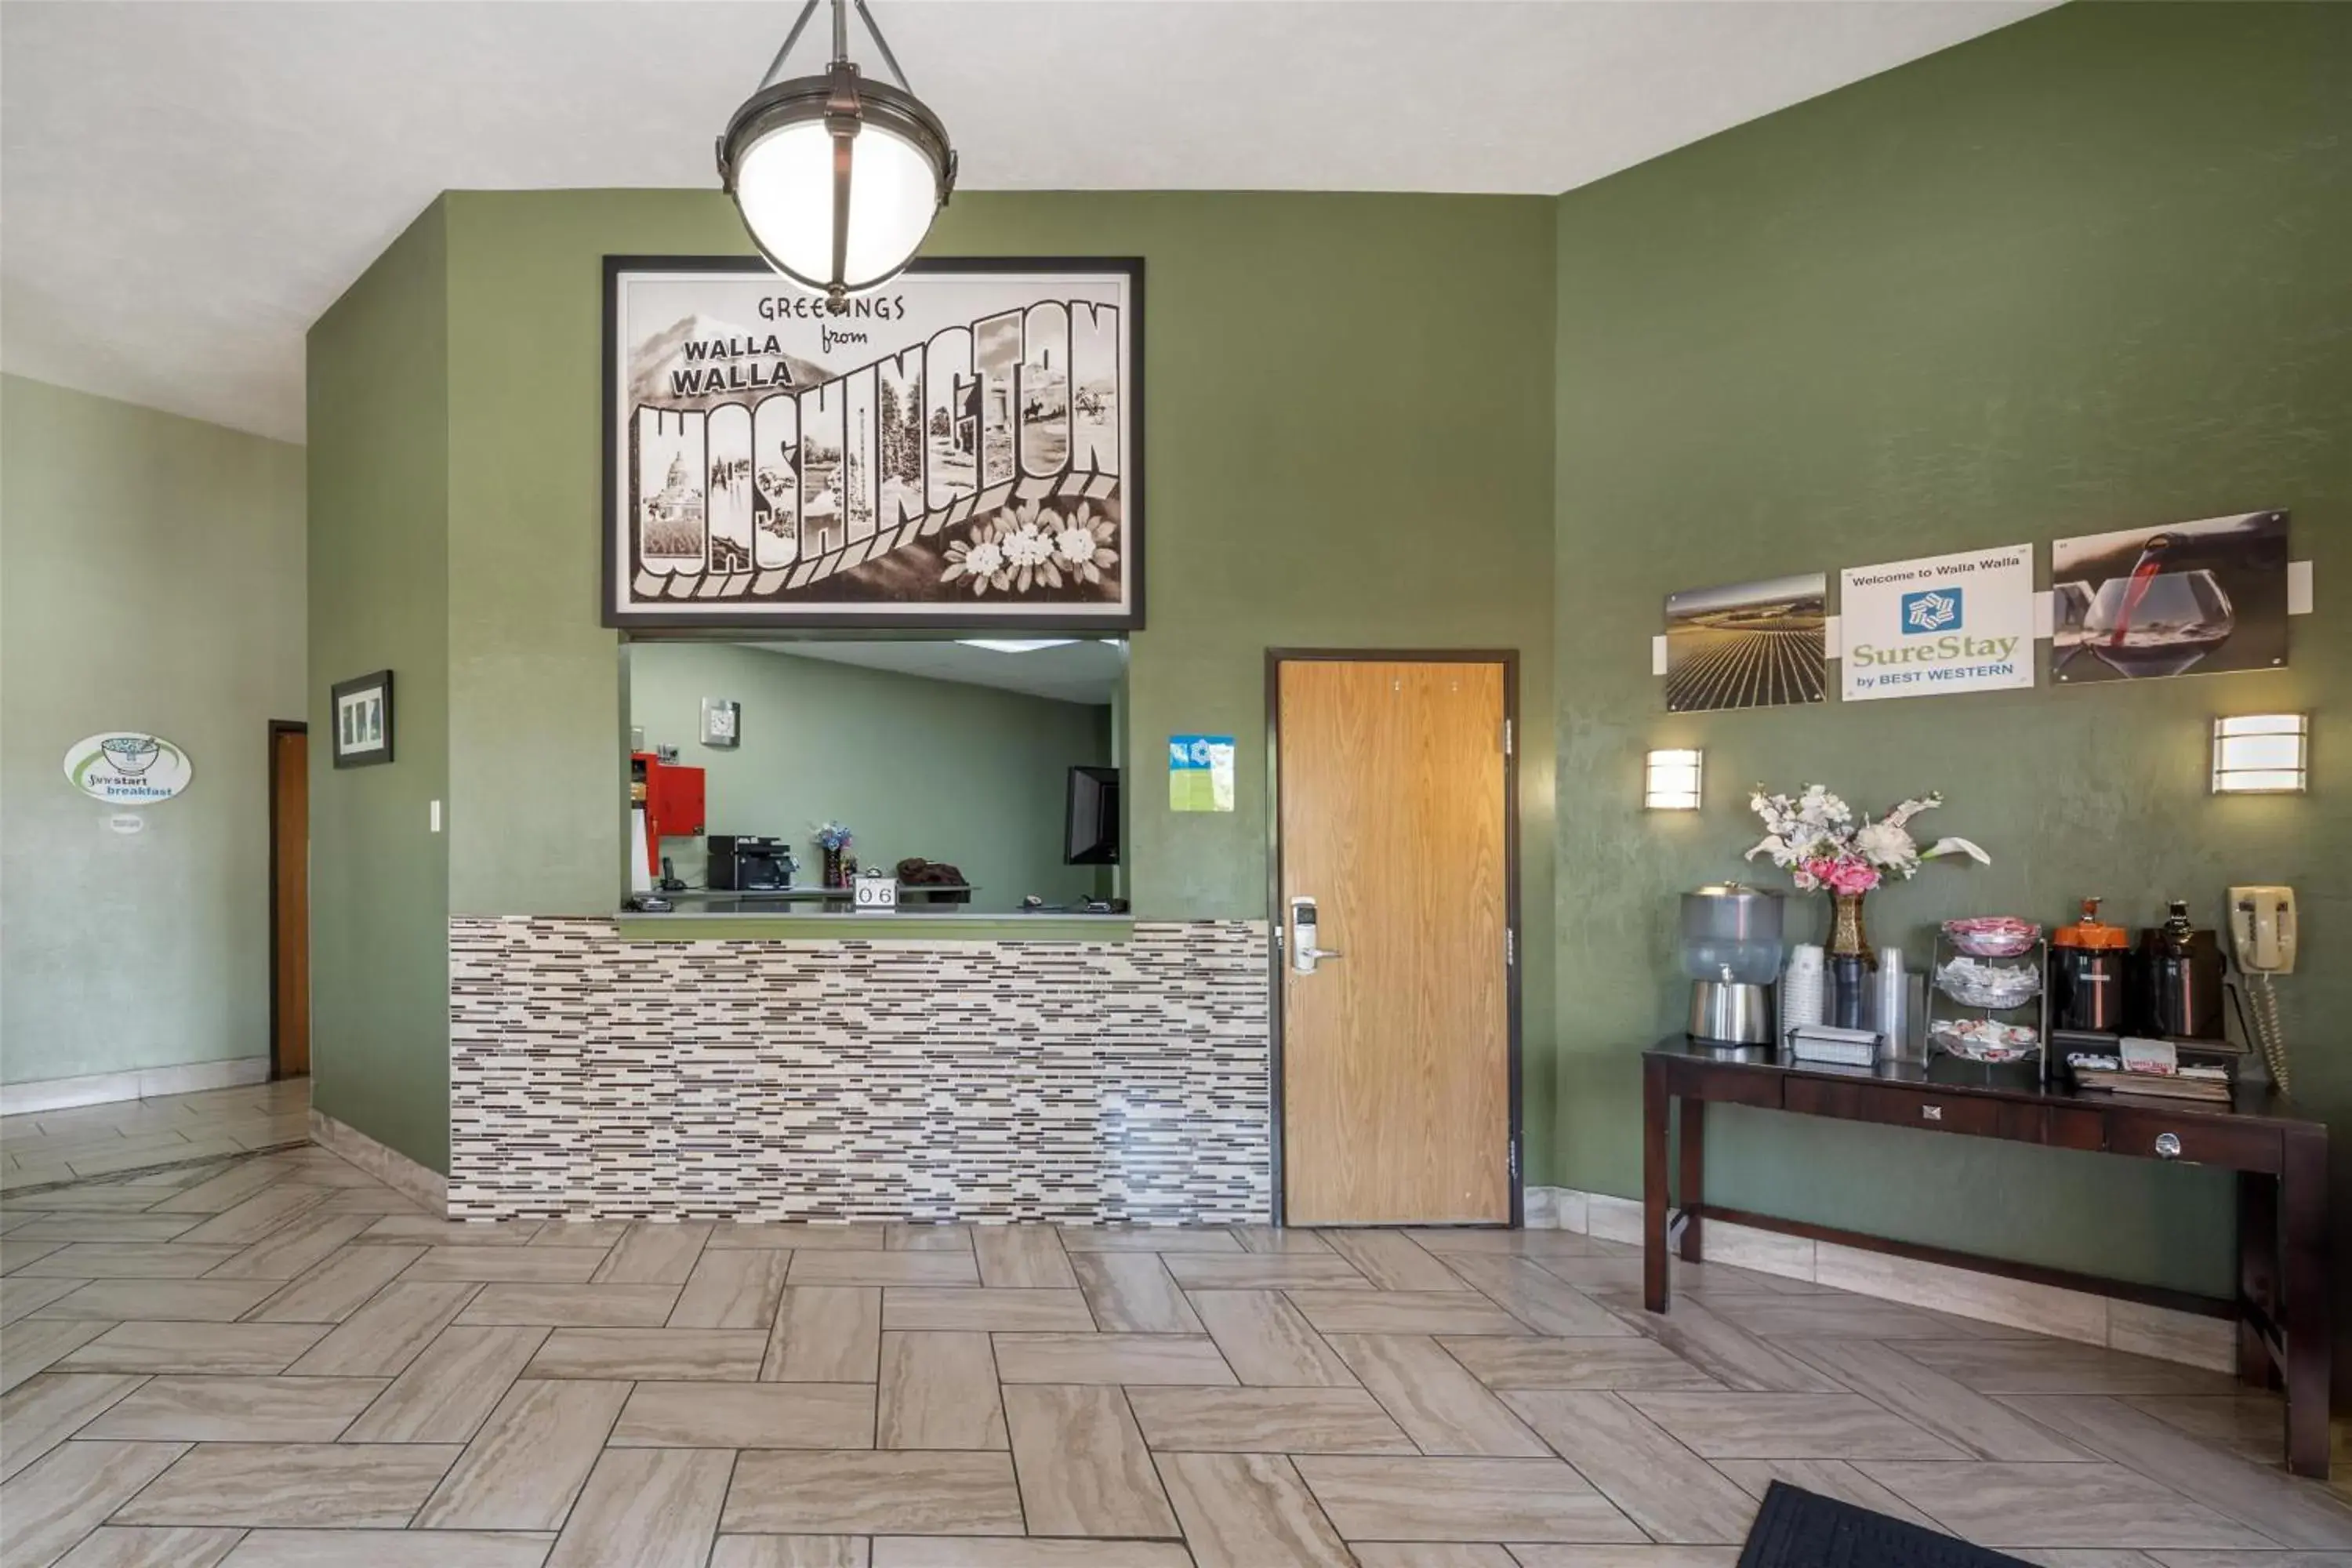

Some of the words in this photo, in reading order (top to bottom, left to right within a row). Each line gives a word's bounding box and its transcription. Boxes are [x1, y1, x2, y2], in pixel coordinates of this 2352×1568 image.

[758, 296, 905, 321] GREEINGS
[684, 335, 782, 361] WALLA
[821, 323, 868, 353] from
[672, 361, 793, 393] WALLA
[635, 299, 1120, 577] WASHINGTON
[1853, 570, 1915, 586] Welcome
[1918, 569, 1933, 579] to
[1936, 561, 1976, 575] Walla
[1980, 556, 2020, 572] Walla
[1853, 636, 2020, 667] SureStay
[1857, 677, 1875, 688] by
[1879, 671, 1922, 686] BEST
[1928, 664, 2014, 681] WESTERN
[107, 786, 172, 797] breakfast
